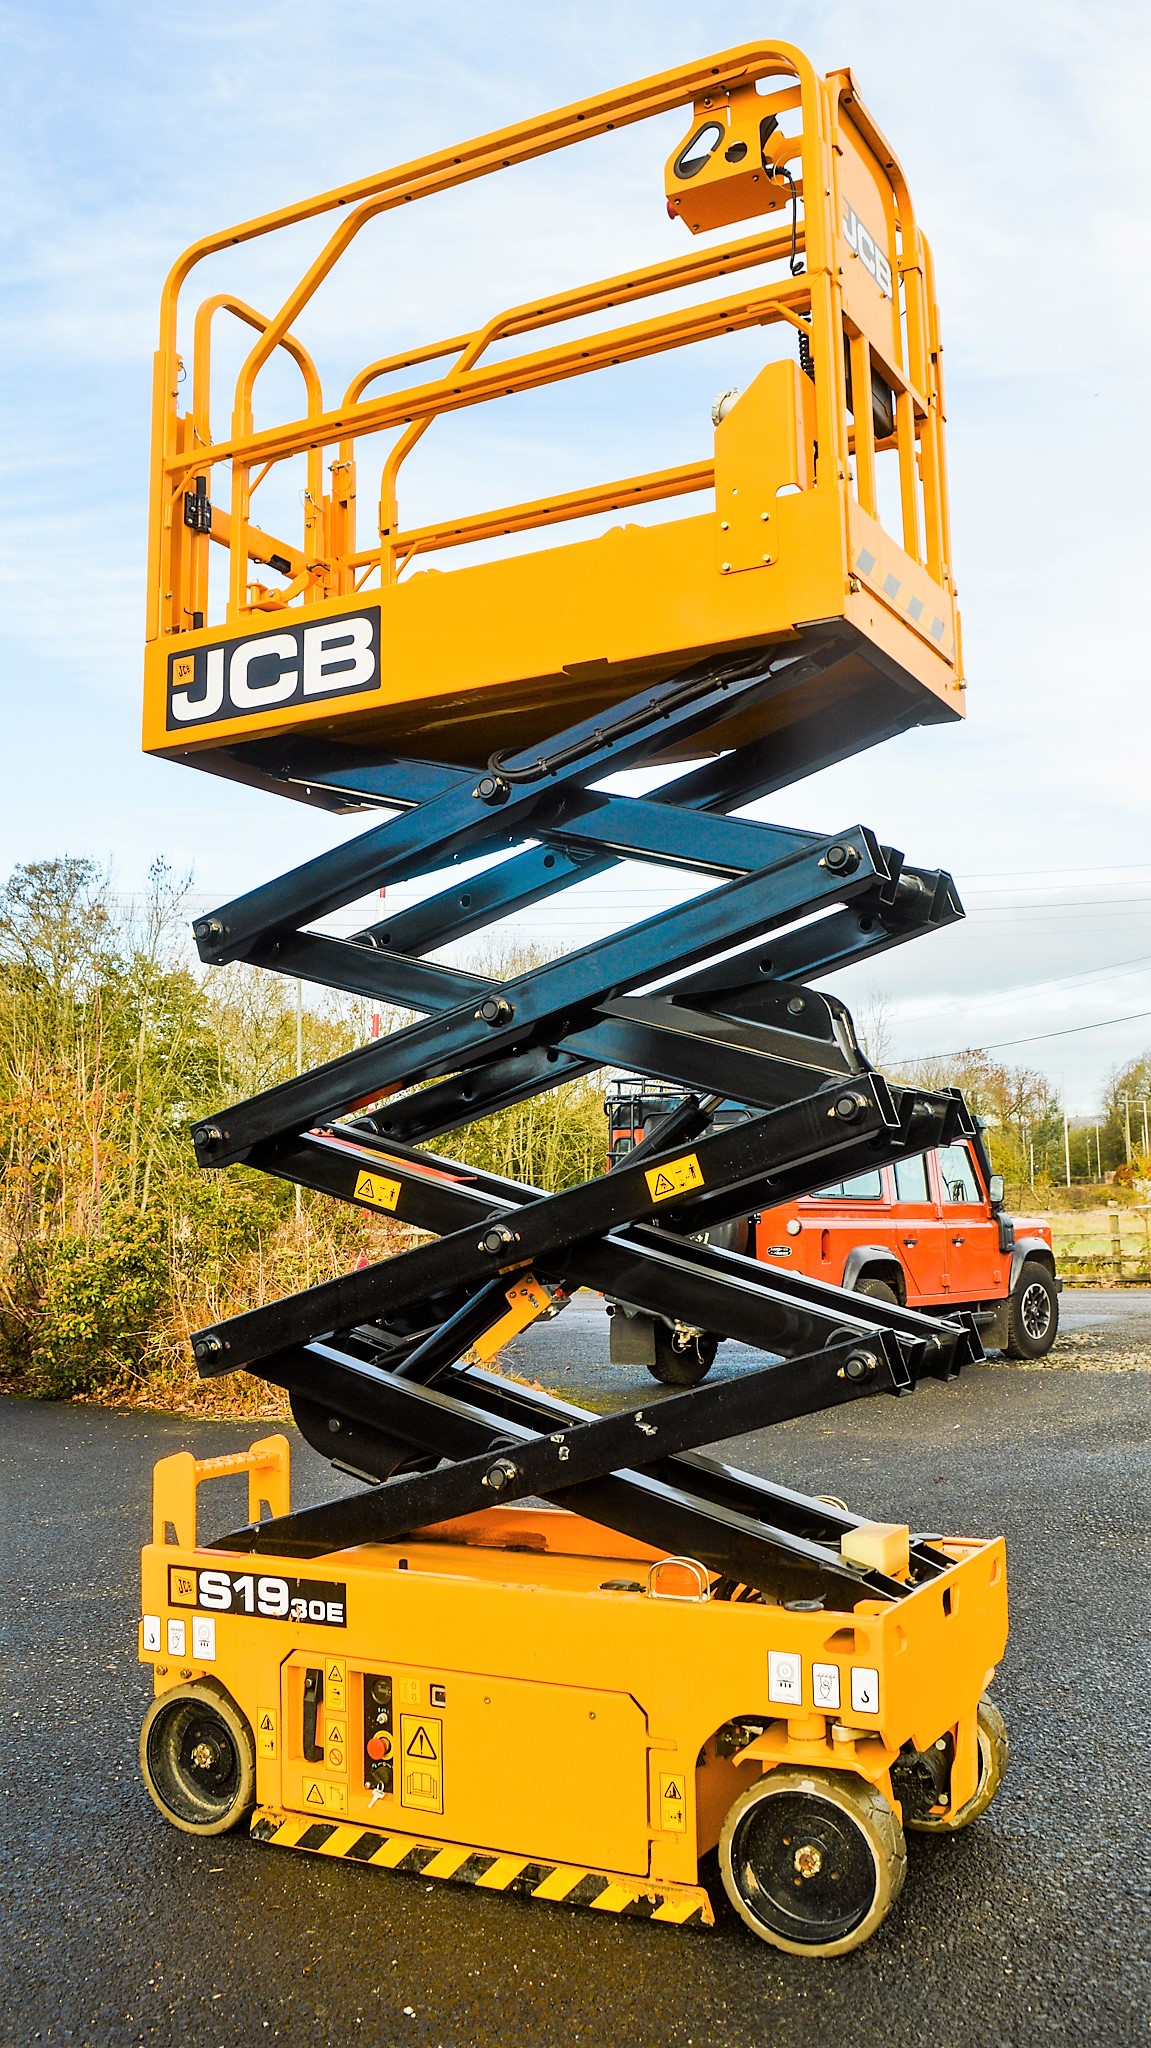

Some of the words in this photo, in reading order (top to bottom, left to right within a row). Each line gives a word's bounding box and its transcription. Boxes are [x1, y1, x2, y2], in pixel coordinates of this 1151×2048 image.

[842, 211, 893, 299] JCB
[171, 617, 376, 722] JCB
[178, 665, 191, 678] JCB
[178, 1578, 193, 1594] JCB
